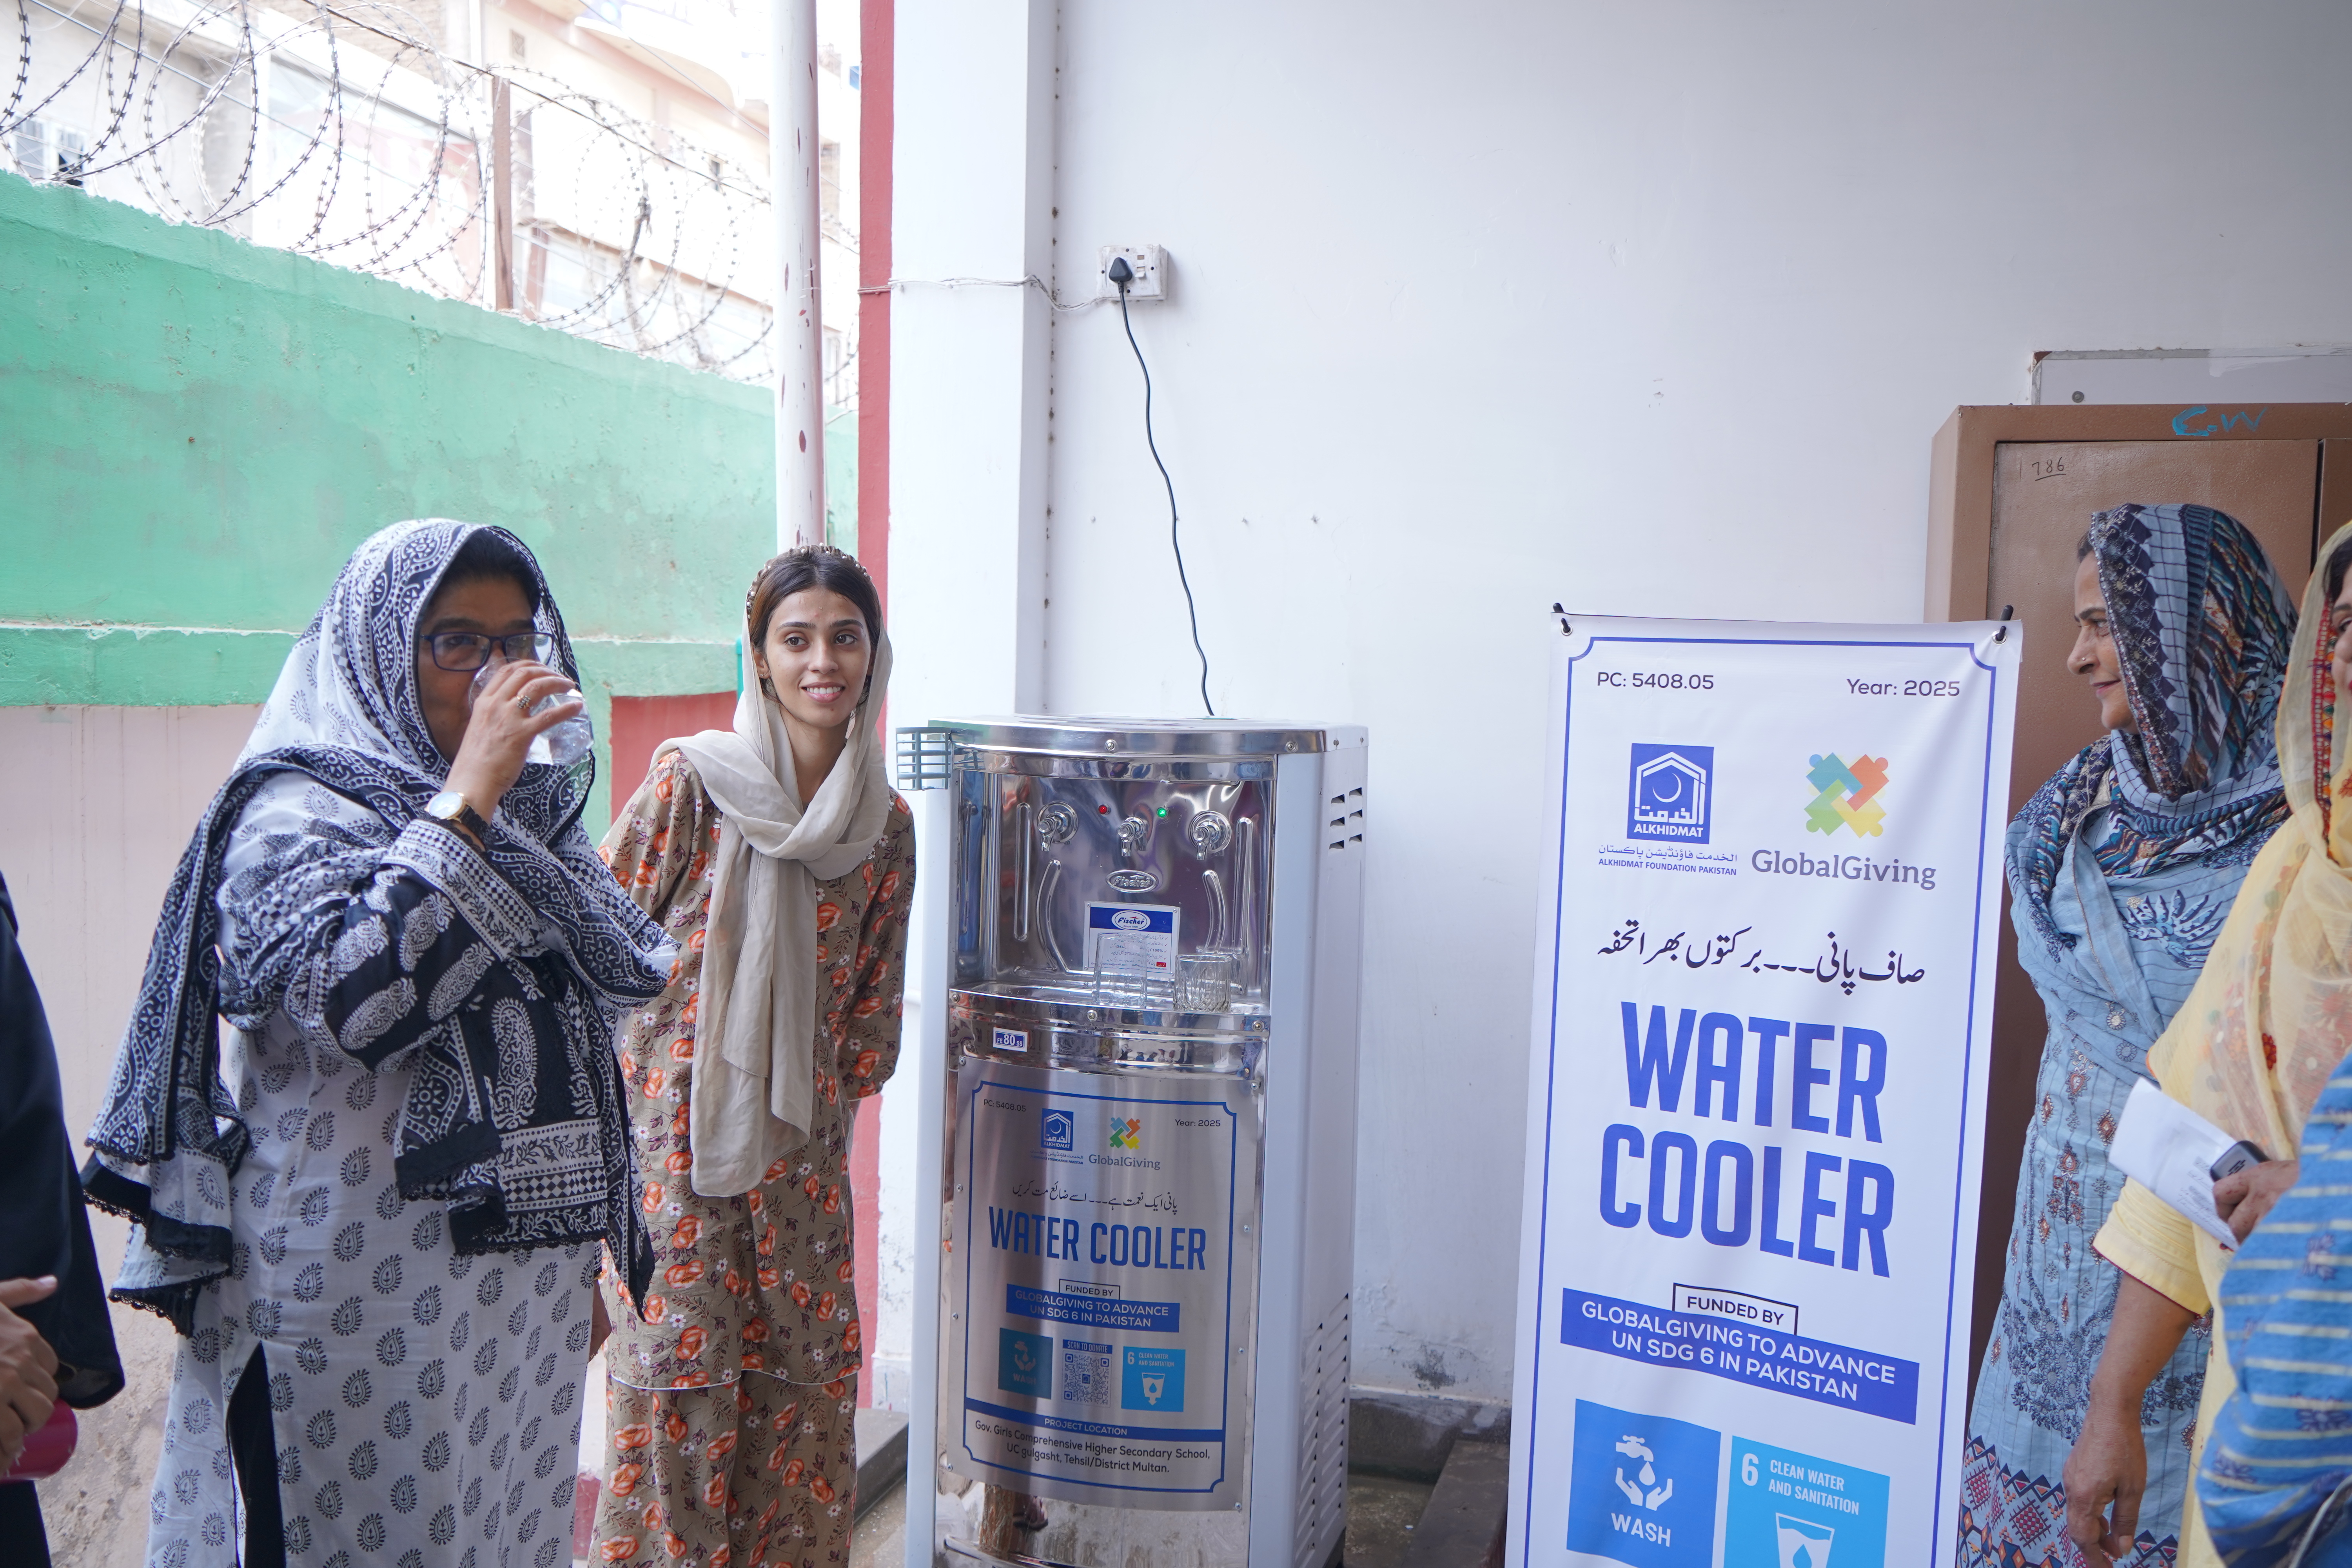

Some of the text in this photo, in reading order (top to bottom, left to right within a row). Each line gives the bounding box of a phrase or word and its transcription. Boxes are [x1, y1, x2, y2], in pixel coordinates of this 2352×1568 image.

[2032, 456, 2065, 475] 786
[1597, 671, 1714, 690] PC: 5408.05
[1846, 679, 1960, 697] Year: 2025
[1633, 823, 1704, 837] ALKHIDMAT
[1599, 844, 1643, 859] پاکستان
[1696, 852, 1737, 862] الخدمت
[1598, 858, 1737, 876] ALKHIDMAT FOUNDATION PAKISTAN
[1751, 849, 1936, 891] GlobalGiving
[1859, 950, 1925, 984] صاف
[1004, 1034, 1015, 1045] 80
[1621, 1001, 1887, 1143] WATER
[984, 1099, 1026, 1112] PC: 5408.05
[1089, 1154, 1160, 1170] GlobalGiving
[1163, 1192, 1177, 1215] پانی
[1599, 1123, 1895, 1278] COOLER
[988, 1206, 1207, 1271] WATER COOLER
[1065, 1285, 1100, 1295] FUNDED
[1016, 1290, 1169, 1316] GLOBALGIVING TO ADVANCE
[1687, 1296, 1784, 1327] FUNDED BY
[1030, 1305, 1151, 1327] UN SDG 6 IN PAKISTAN
[1067, 1341, 1080, 1349] SCAN
[1089, 1344, 1107, 1353] DONATE
[1581, 1301, 1896, 1385] GLOBALGIVING TO ADVANCE
[1127, 1352, 1134, 1365] 6
[1612, 1330, 1858, 1401] UN SDG 6 IN PAKISTAN
[1013, 1373, 1036, 1385] WASH
[1044, 1418, 1127, 1436] PROJECT LOCATION
[975, 1420, 1210, 1461] Gov. Girls Comprehensive Higher Secondary School,
[1007, 1443, 1169, 1473] UC gulgasht, Tehsil/District Multan.
[1741, 1452, 1845, 1492] 6 CLEAN WATER
[1768, 1478, 1860, 1516] AND SANITATION
[1611, 1512, 1671, 1548] WASH
